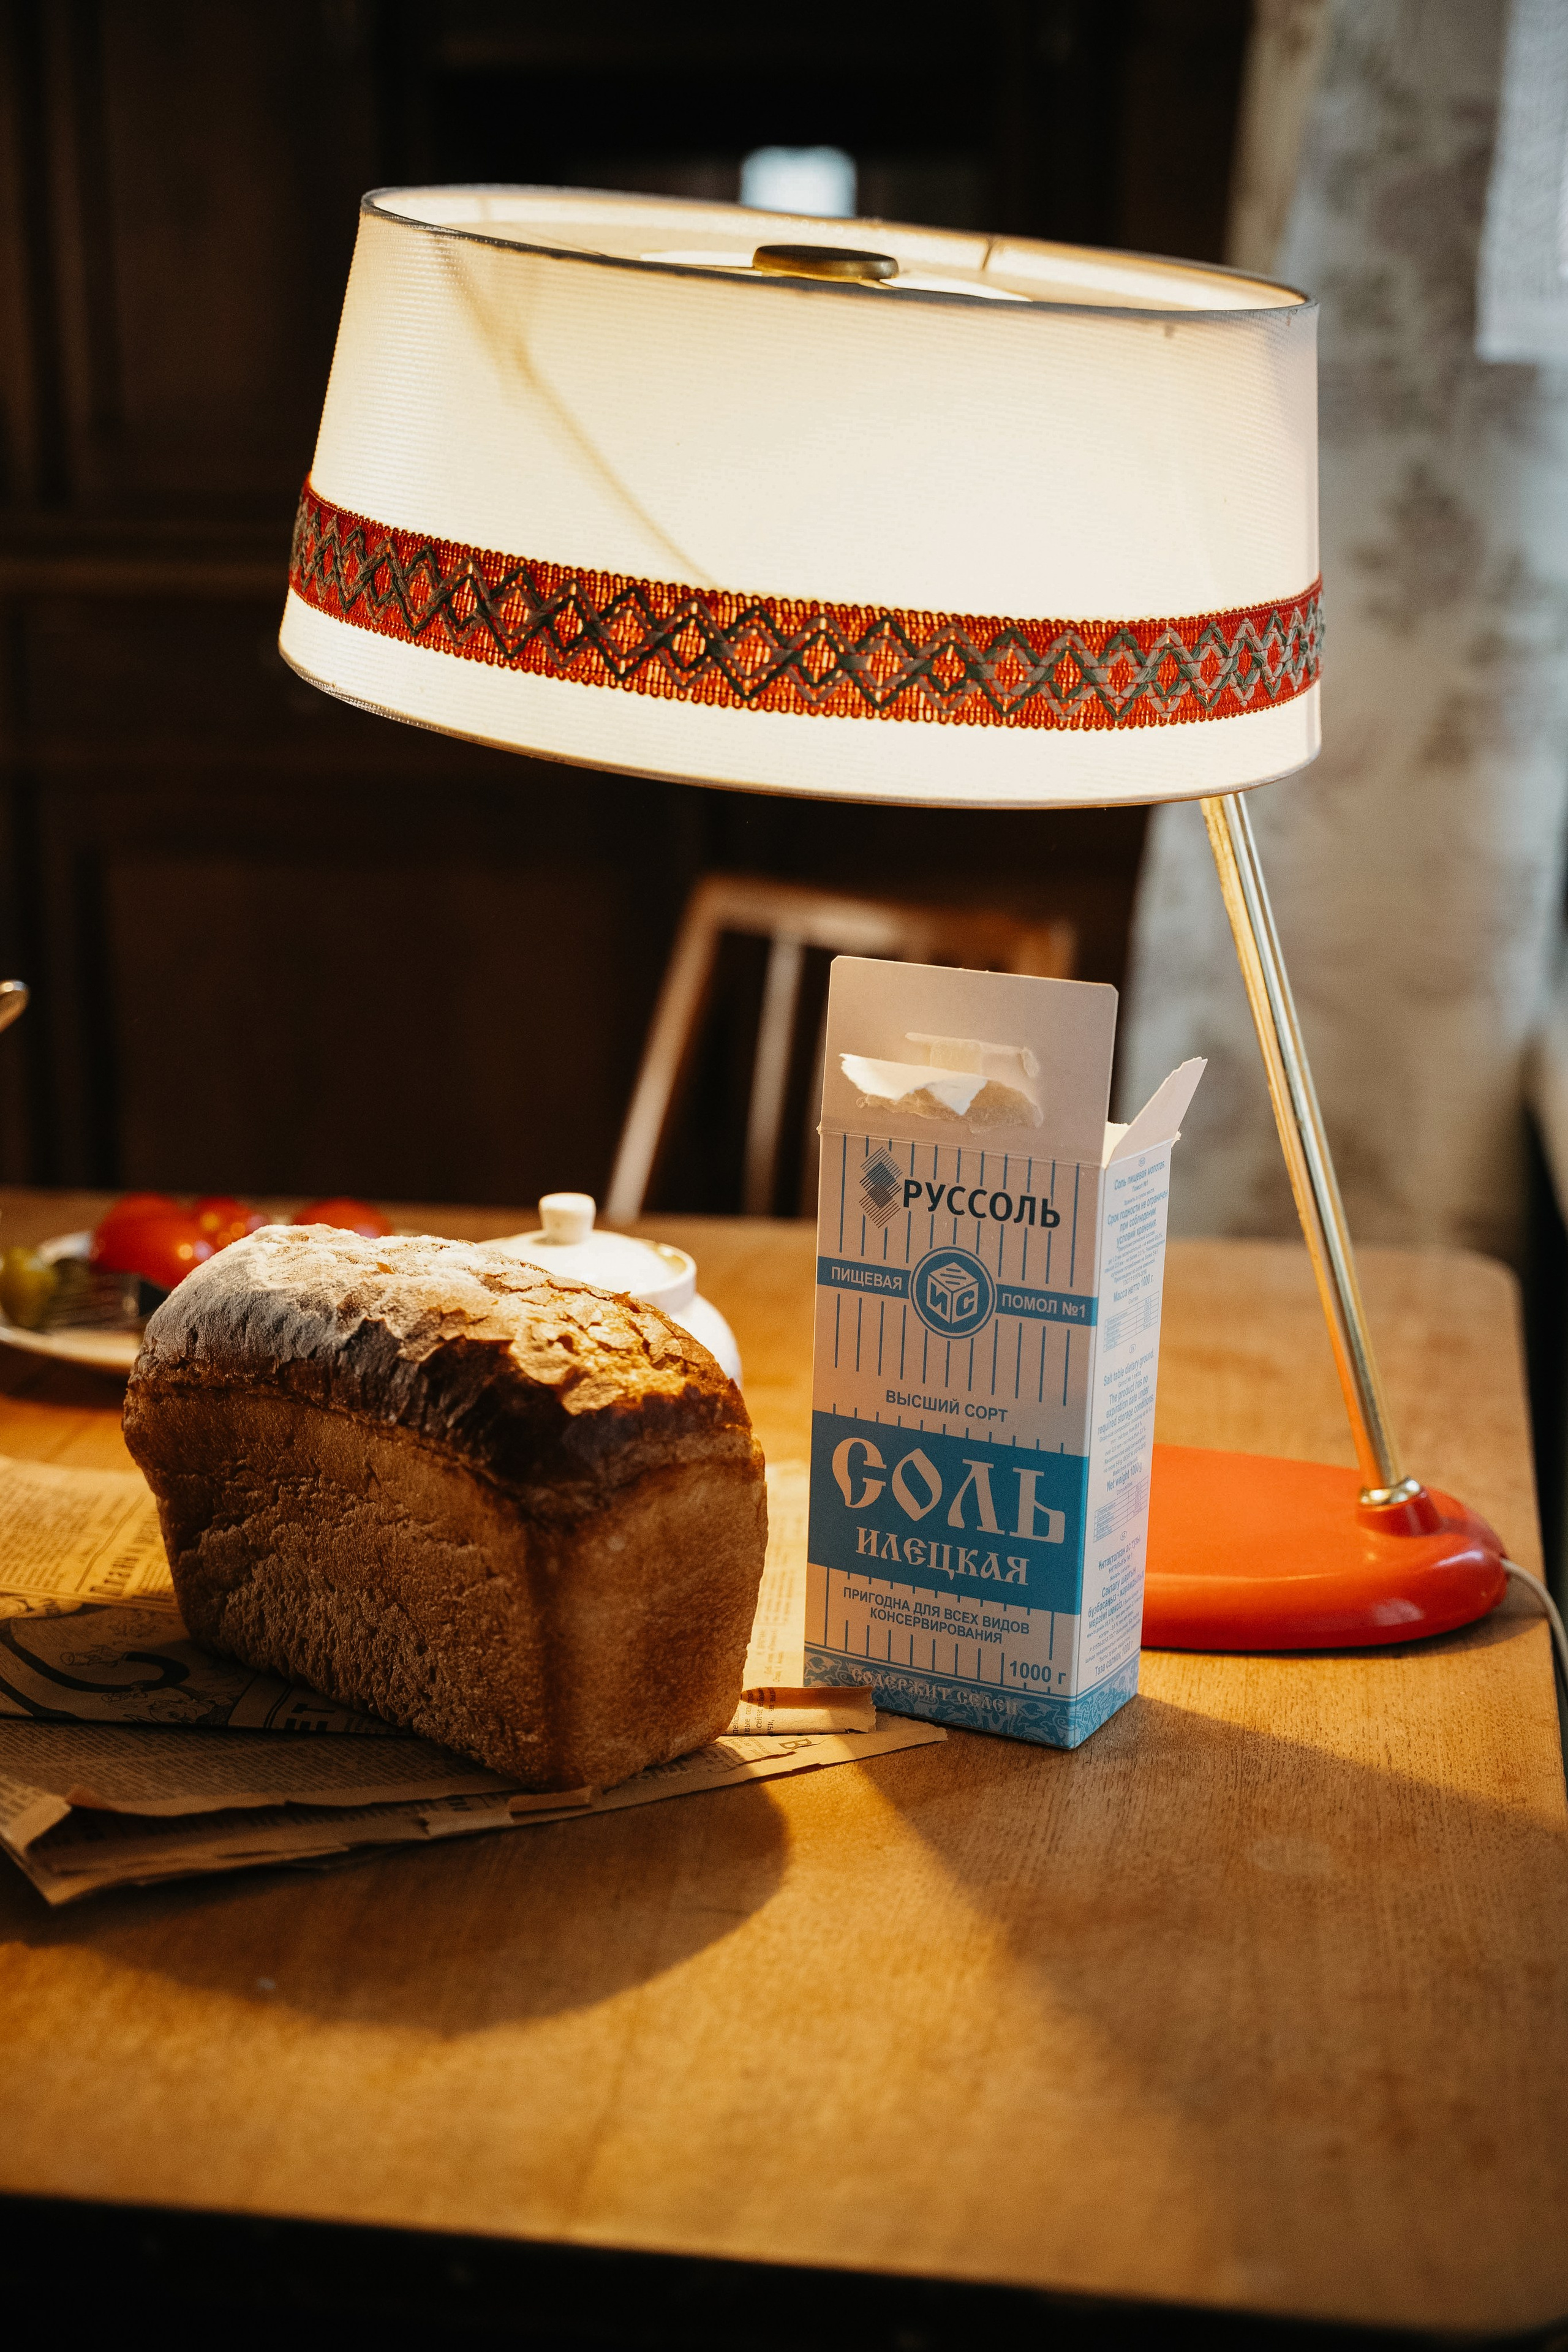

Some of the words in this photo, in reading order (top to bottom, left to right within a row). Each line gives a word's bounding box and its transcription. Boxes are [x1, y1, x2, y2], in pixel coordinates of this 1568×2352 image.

[1114, 1178, 1126, 1190] Соль
[1127, 1169, 1147, 1183] пищевая
[903, 1179, 1061, 1228] РУССОЛЬ
[1107, 1213, 1118, 1226] Срок
[1120, 1203, 1140, 1219] годности
[1120, 1221, 1128, 1231] при
[1129, 1207, 1156, 1227] соблюдении
[1117, 1227, 1136, 1248] условий
[831, 1266, 902, 1290] ПИЩЕВАЯ
[1114, 1288, 1127, 1302] Масса
[1128, 1281, 1140, 1294] нетто
[1141, 1273, 1150, 1287] 1000
[1001, 1292, 1057, 1314] ПОМОЛ
[1061, 1301, 1085, 1317] №1
[1103, 1373, 1112, 1386] Salt
[1113, 1367, 1124, 1381] table
[1125, 1360, 1138, 1374] dietary
[1106, 1400, 1128, 1418] expiration
[1128, 1393, 1137, 1405] date
[1138, 1385, 1149, 1399] under
[1109, 1393, 1117, 1404] The
[1118, 1381, 1134, 1402] product
[1142, 1374, 1148, 1384] no
[886, 1389, 960, 1417] ВЫСШИЙ
[963, 1403, 1008, 1423] СОРТ
[1097, 1415, 1117, 1434] required
[1117, 1408, 1133, 1423] storage
[832, 1437, 1065, 1544] СОЛЬ
[1106, 1479, 1115, 1491] Net
[1115, 1469, 1129, 1486] weight
[1130, 1461, 1139, 1476] 1000
[1139, 1461, 1142, 1473] g
[856, 1527, 1030, 1586] ИЛЕЦКАЯ
[1126, 1542, 1130, 1553] ас
[843, 1587, 910, 1611] ПРИГОДНА
[913, 1599, 940, 1618] ДЛЯ
[944, 1606, 979, 1626] ВСЕХ
[982, 1613, 1030, 1635] ВИДОВ
[870, 1608, 1002, 1644] КОНСЕРВИРОВАНИЯ
[1009, 1660, 1052, 1683] 1000
[1058, 1672, 1066, 1684] г
[1095, 1663, 1105, 1676] Таза
[1121, 1640, 1130, 1656] 1000
[850, 1668, 949, 1702] СОДЕРЖИТ
